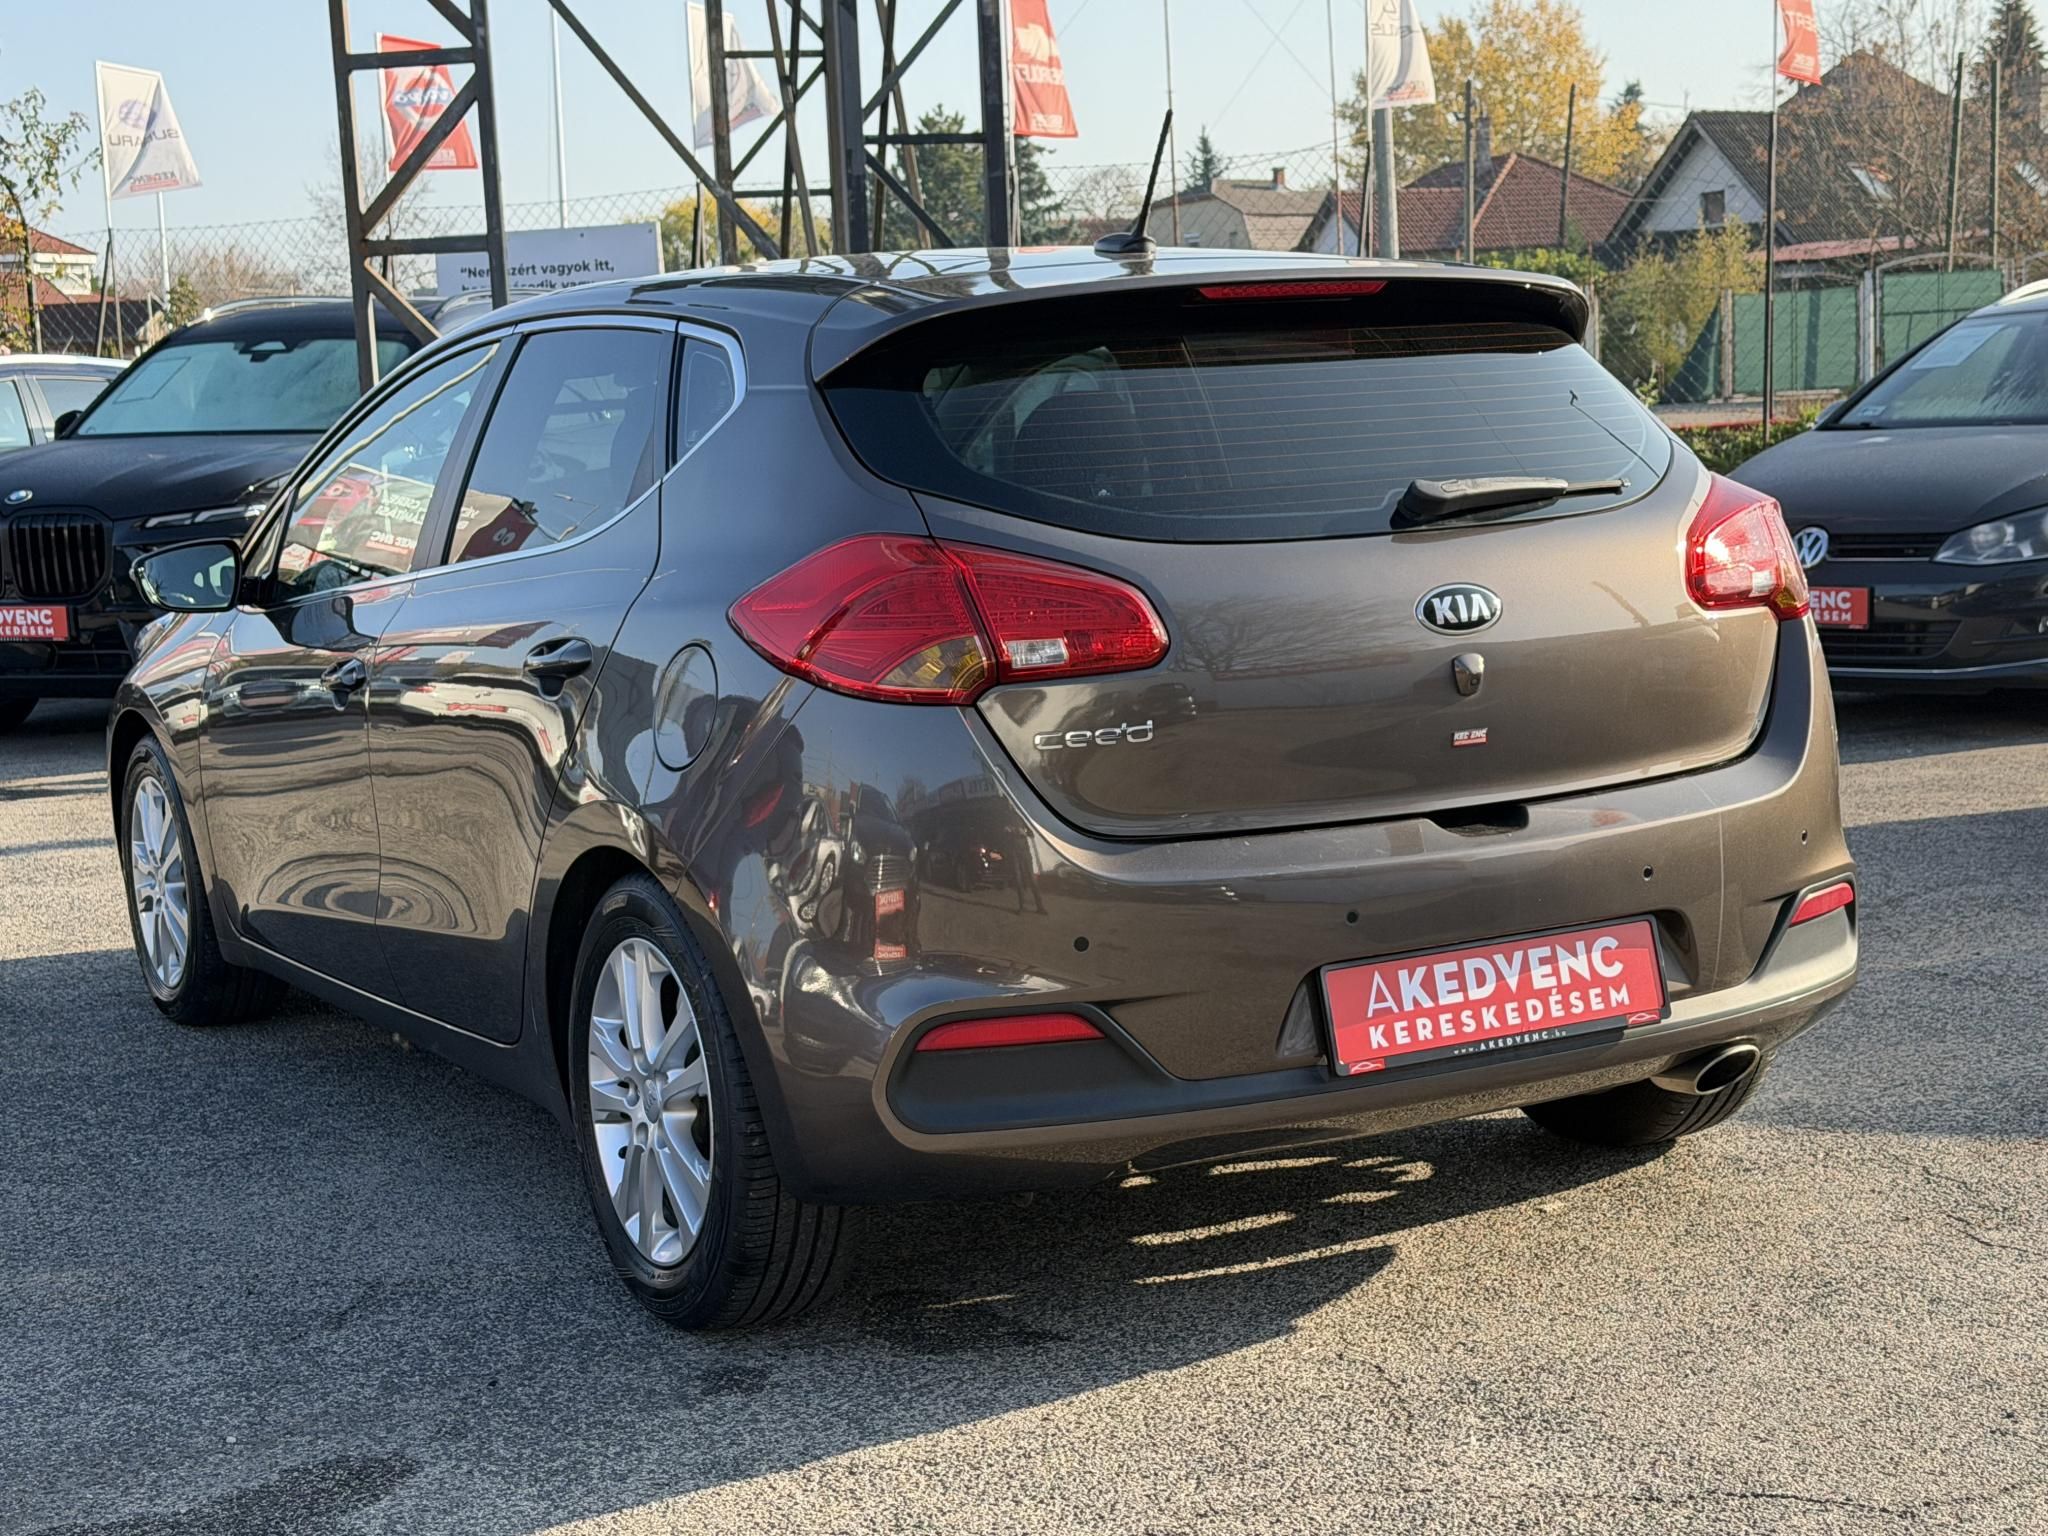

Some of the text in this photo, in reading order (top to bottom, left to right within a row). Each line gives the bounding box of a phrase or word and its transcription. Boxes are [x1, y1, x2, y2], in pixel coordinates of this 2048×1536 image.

[508, 263, 536, 276] zért
[541, 260, 591, 276] vagyok
[594, 259, 614, 273] itt,
[1431, 593, 1492, 625] KIA
[1369, 984, 1630, 1049] KERESKEDÉSEM
[1454, 1029, 1567, 1055] www.AKEDVENC.hu
